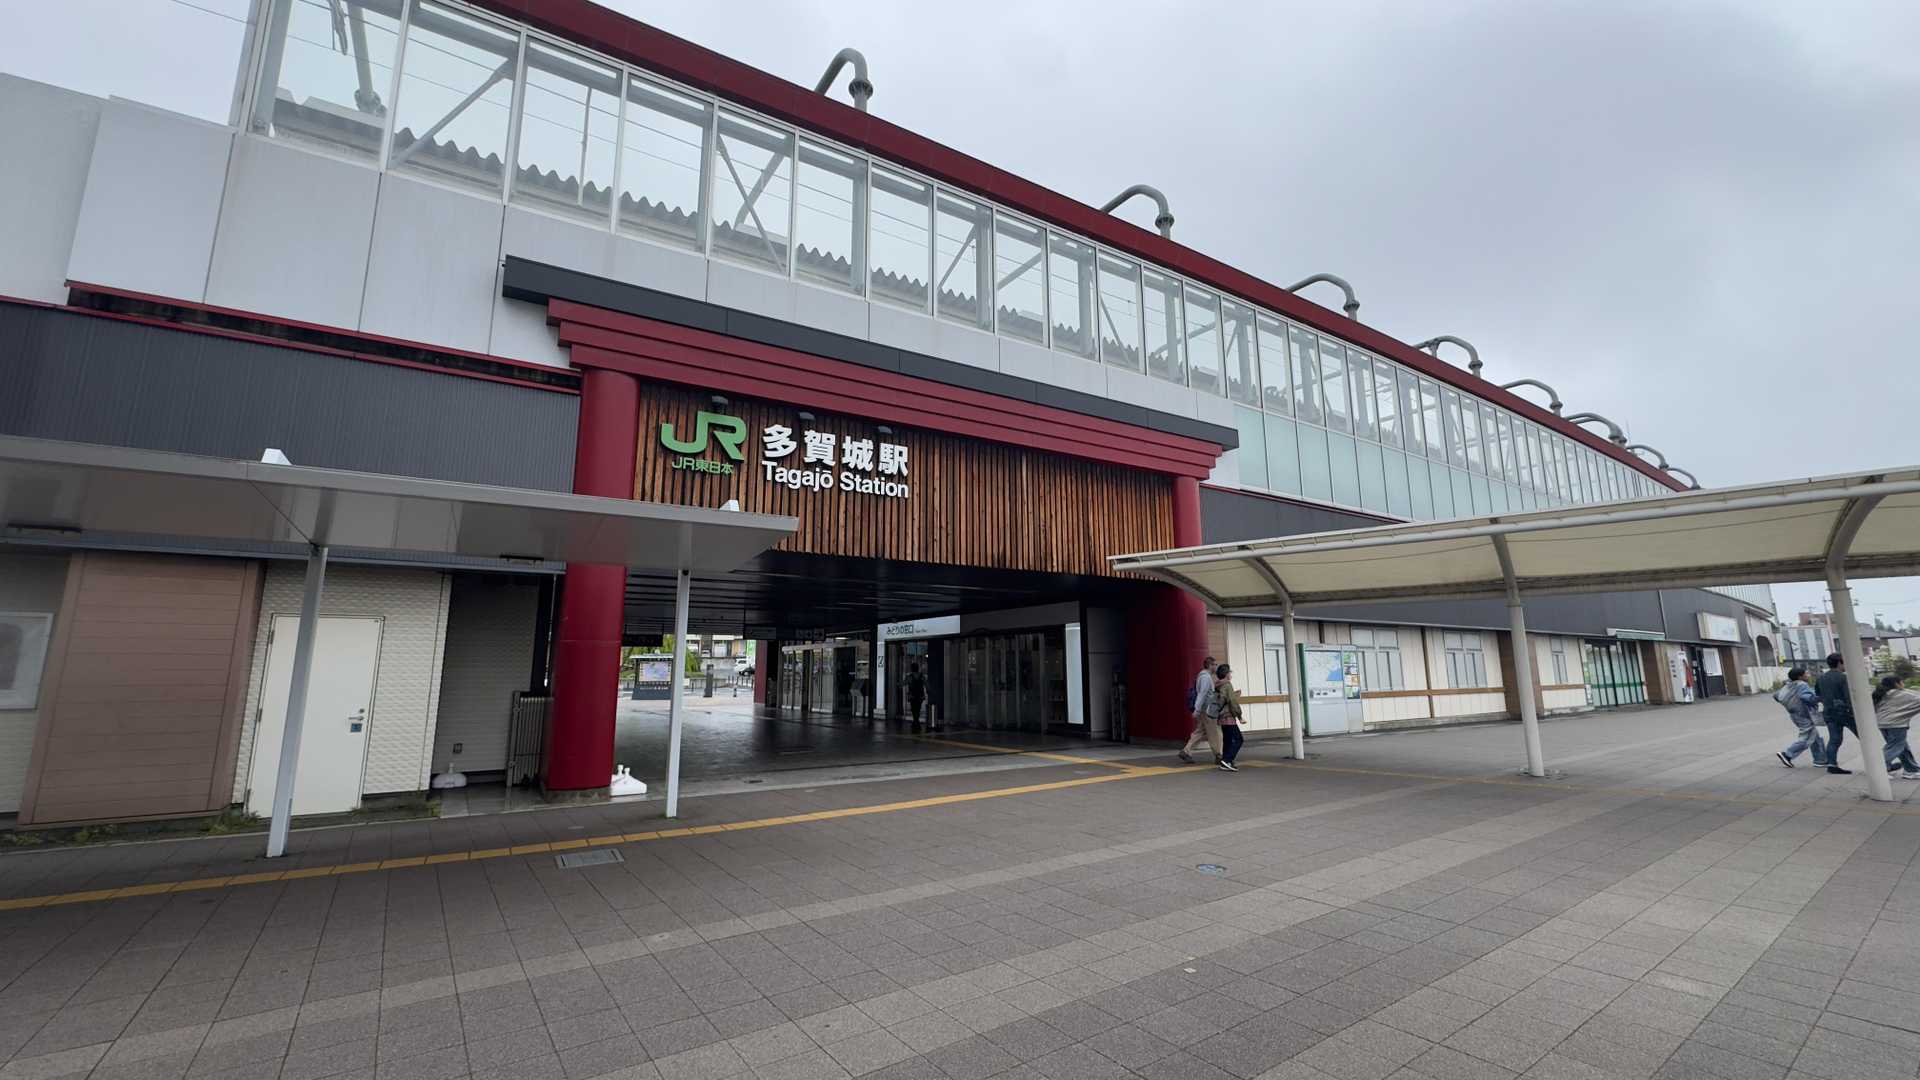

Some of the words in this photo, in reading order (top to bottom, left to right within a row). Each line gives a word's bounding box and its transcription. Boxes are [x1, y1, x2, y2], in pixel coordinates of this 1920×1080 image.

[661, 410, 747, 461] JR
[762, 424, 909, 477] 多賀城駅
[671, 457, 734, 475] JR東日本
[762, 460, 834, 492] Tagajō
[840, 471, 909, 498] Station
